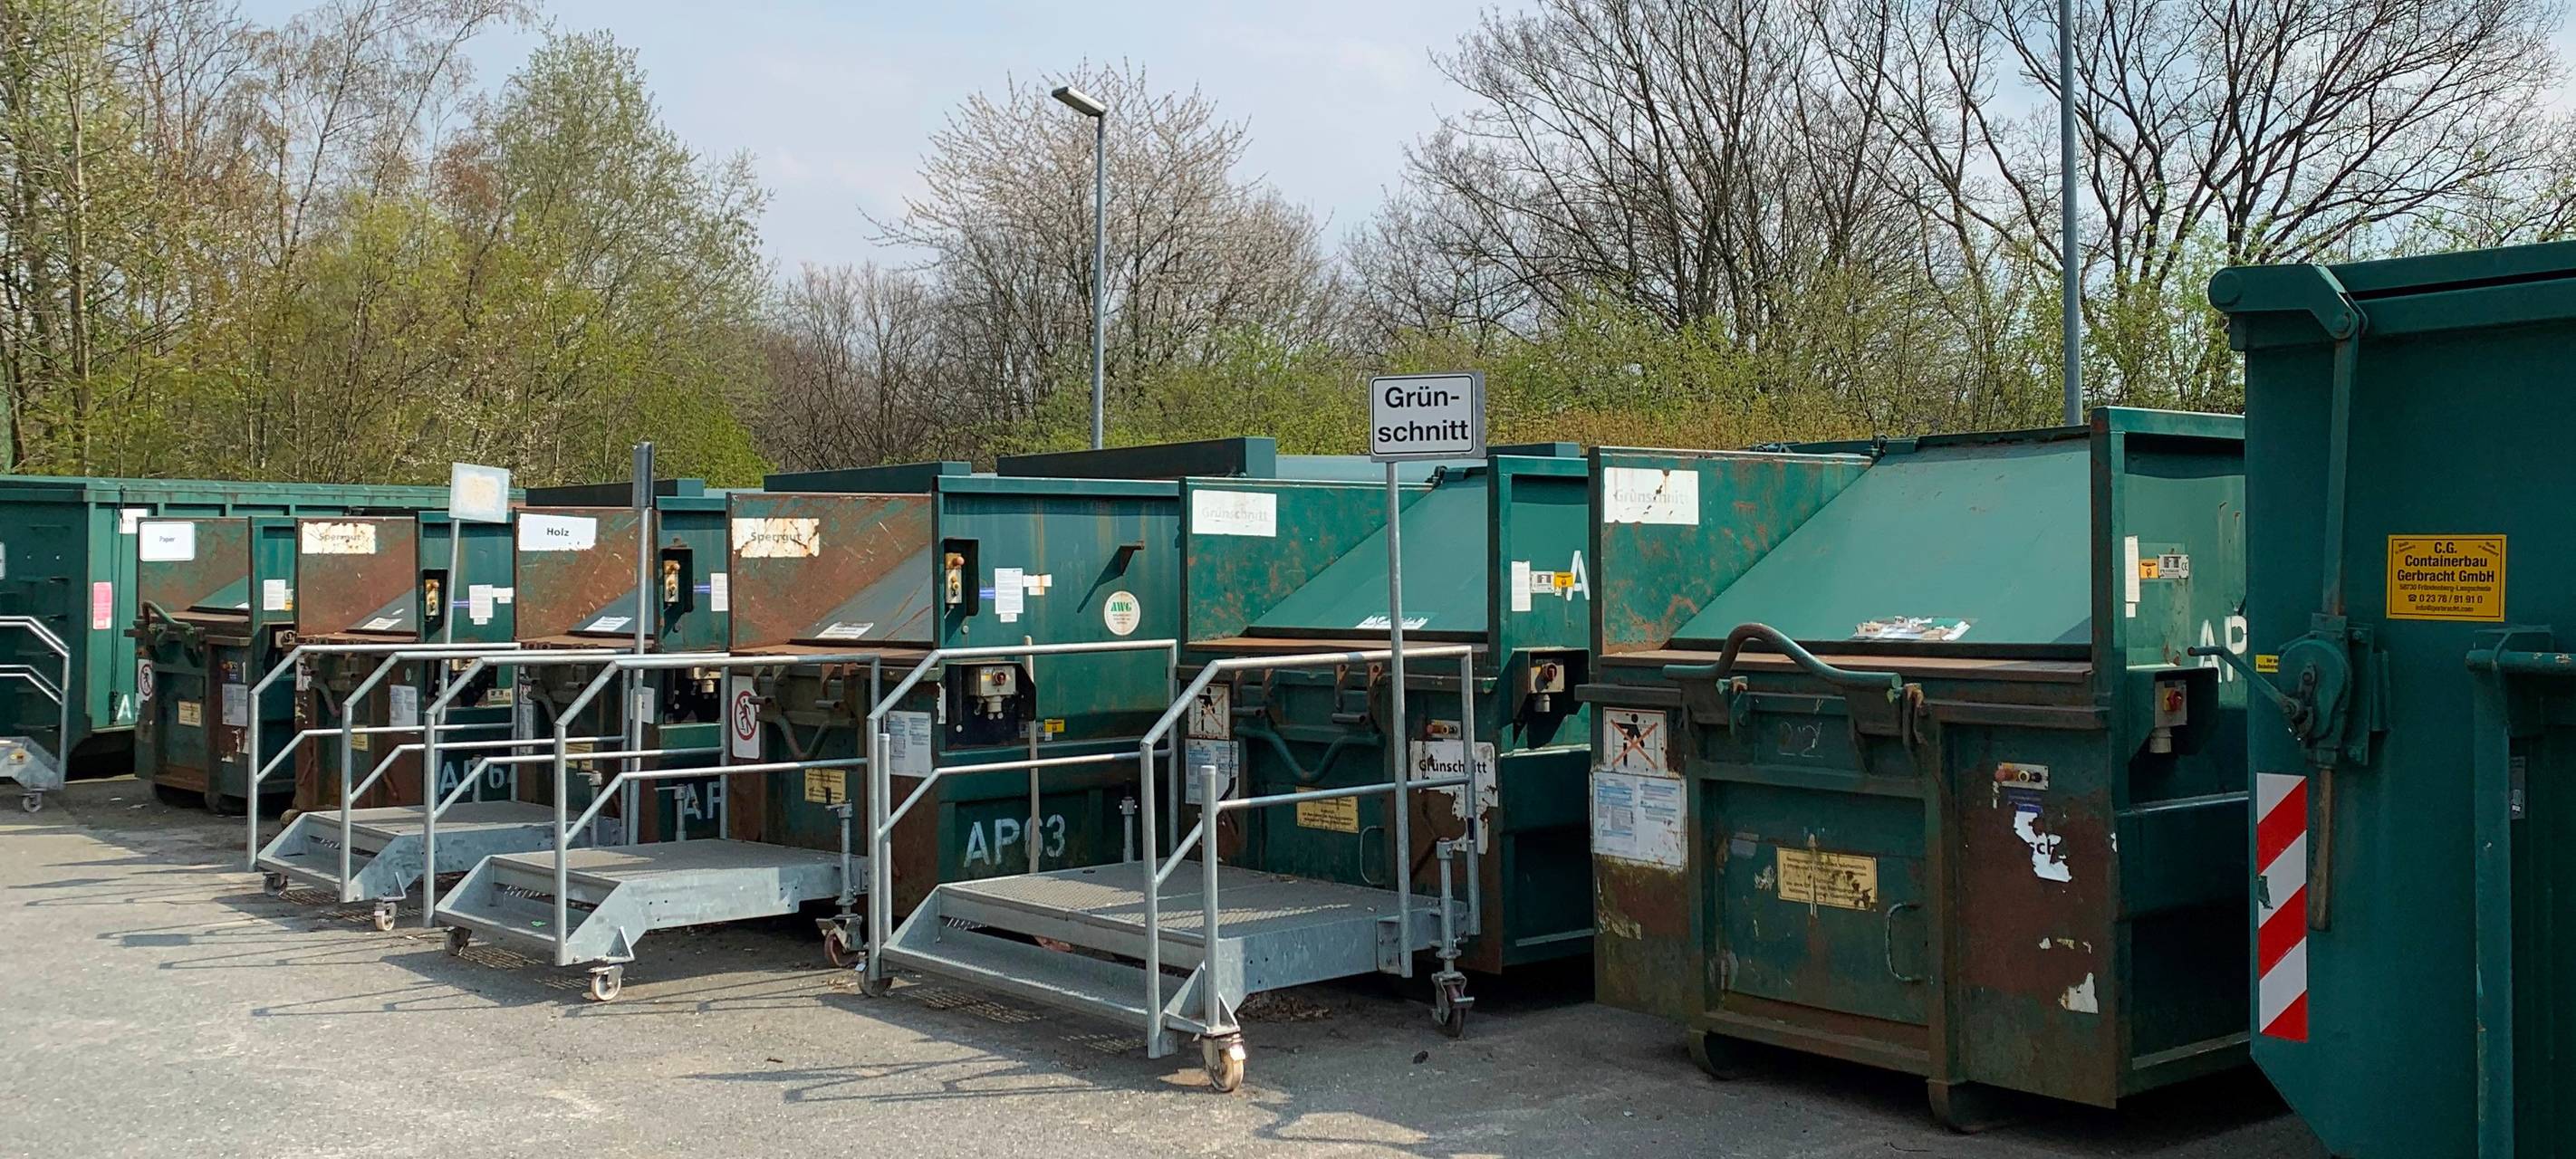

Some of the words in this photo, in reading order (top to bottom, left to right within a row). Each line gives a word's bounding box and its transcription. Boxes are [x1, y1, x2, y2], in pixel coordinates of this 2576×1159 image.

[1384, 385, 1459, 408] Grün-
[1378, 419, 1468, 442] schnitt
[546, 527, 570, 536] Holz
[2434, 541, 2457, 553] C.G.
[2405, 554, 2487, 567] Containerbau
[2398, 569, 2456, 581] Gerbracht
[2458, 570, 2494, 582] GmbH
[2419, 594, 2425, 602] 0
[2426, 594, 2436, 602] 23
[2465, 595, 2475, 603] 91
[2477, 596, 2483, 604] 0
[1110, 601, 1132, 612] AWG
[1419, 759, 1487, 774] Grünschtt
[963, 813, 1066, 868] AP63
